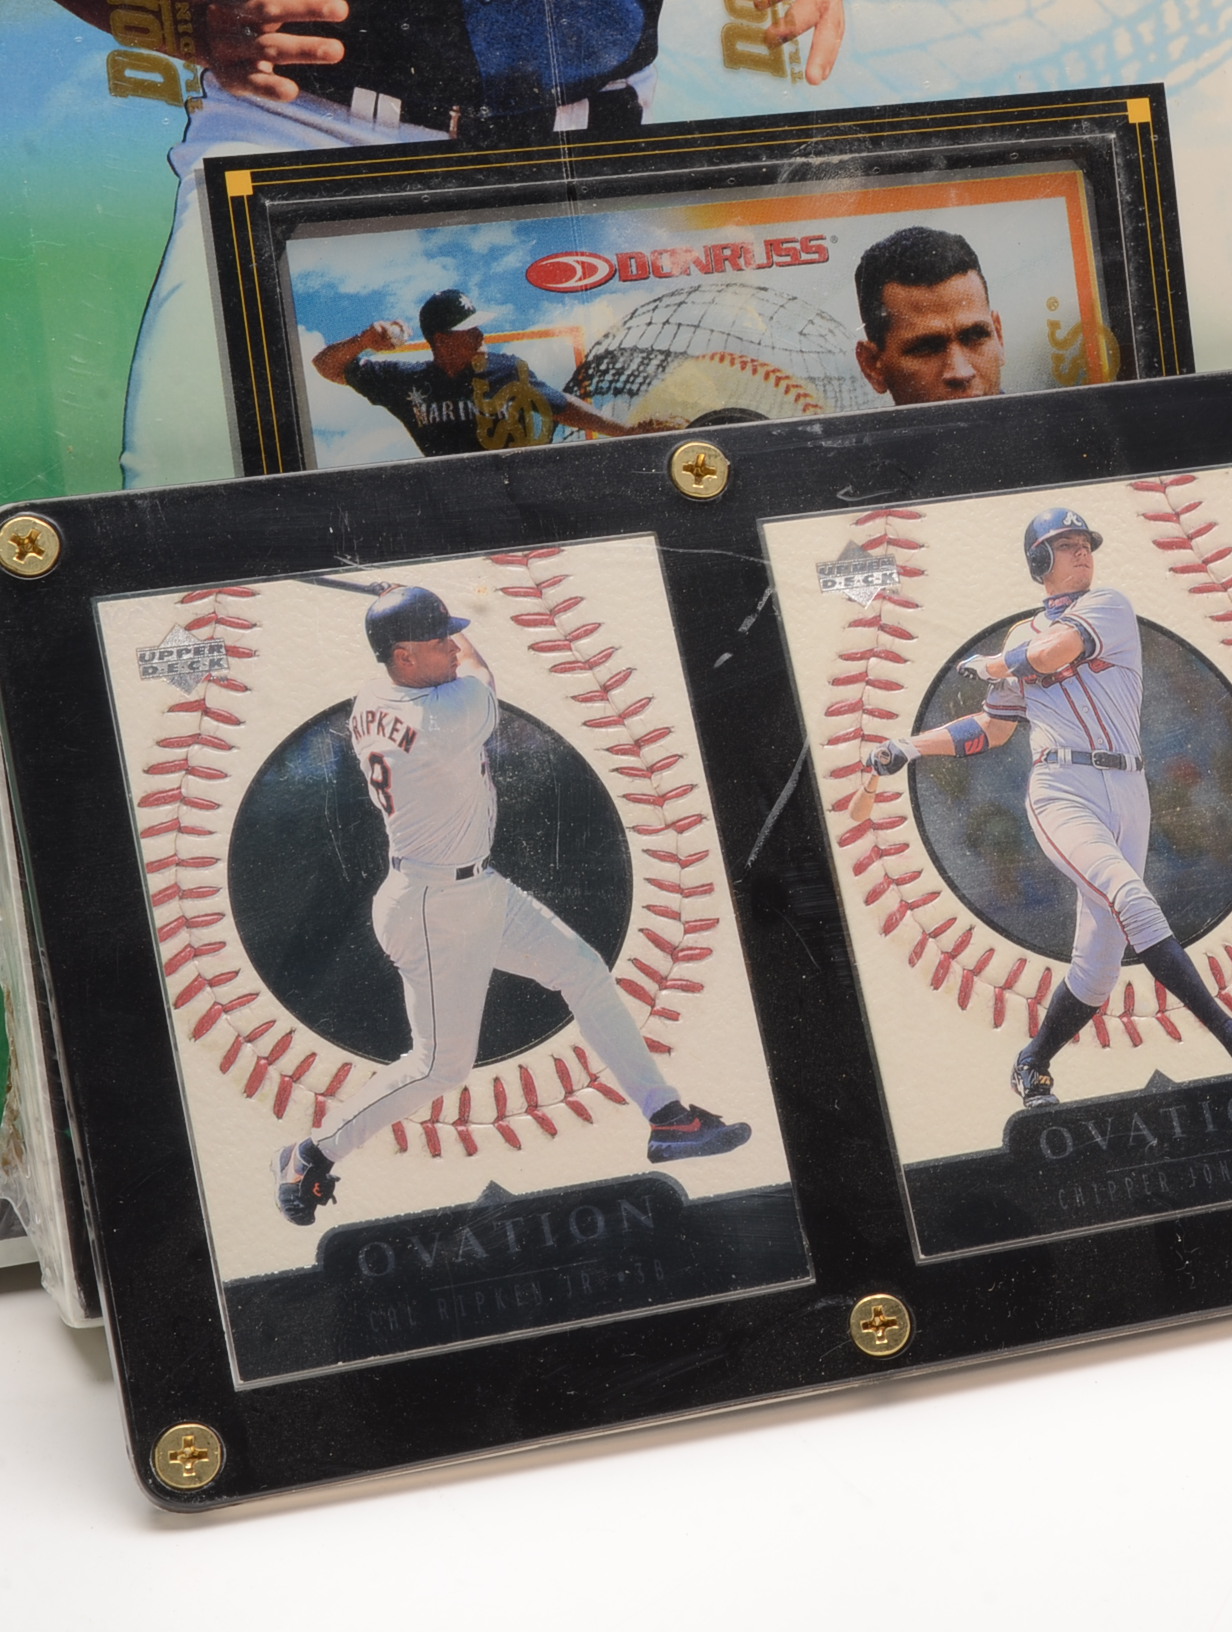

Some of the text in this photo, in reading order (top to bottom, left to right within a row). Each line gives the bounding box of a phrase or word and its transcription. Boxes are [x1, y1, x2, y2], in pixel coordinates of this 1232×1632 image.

[615, 234, 830, 282] DONRUSS
[139, 644, 224, 662] UPPER
[352, 709, 418, 754] RIPKEN
[368, 751, 396, 817] 8
[1057, 1171, 1169, 1210] CHIPPER
[357, 1194, 657, 1278] OVATION
[369, 1303, 418, 1334] CAL
[438, 1279, 544, 1321] RIPKEN
